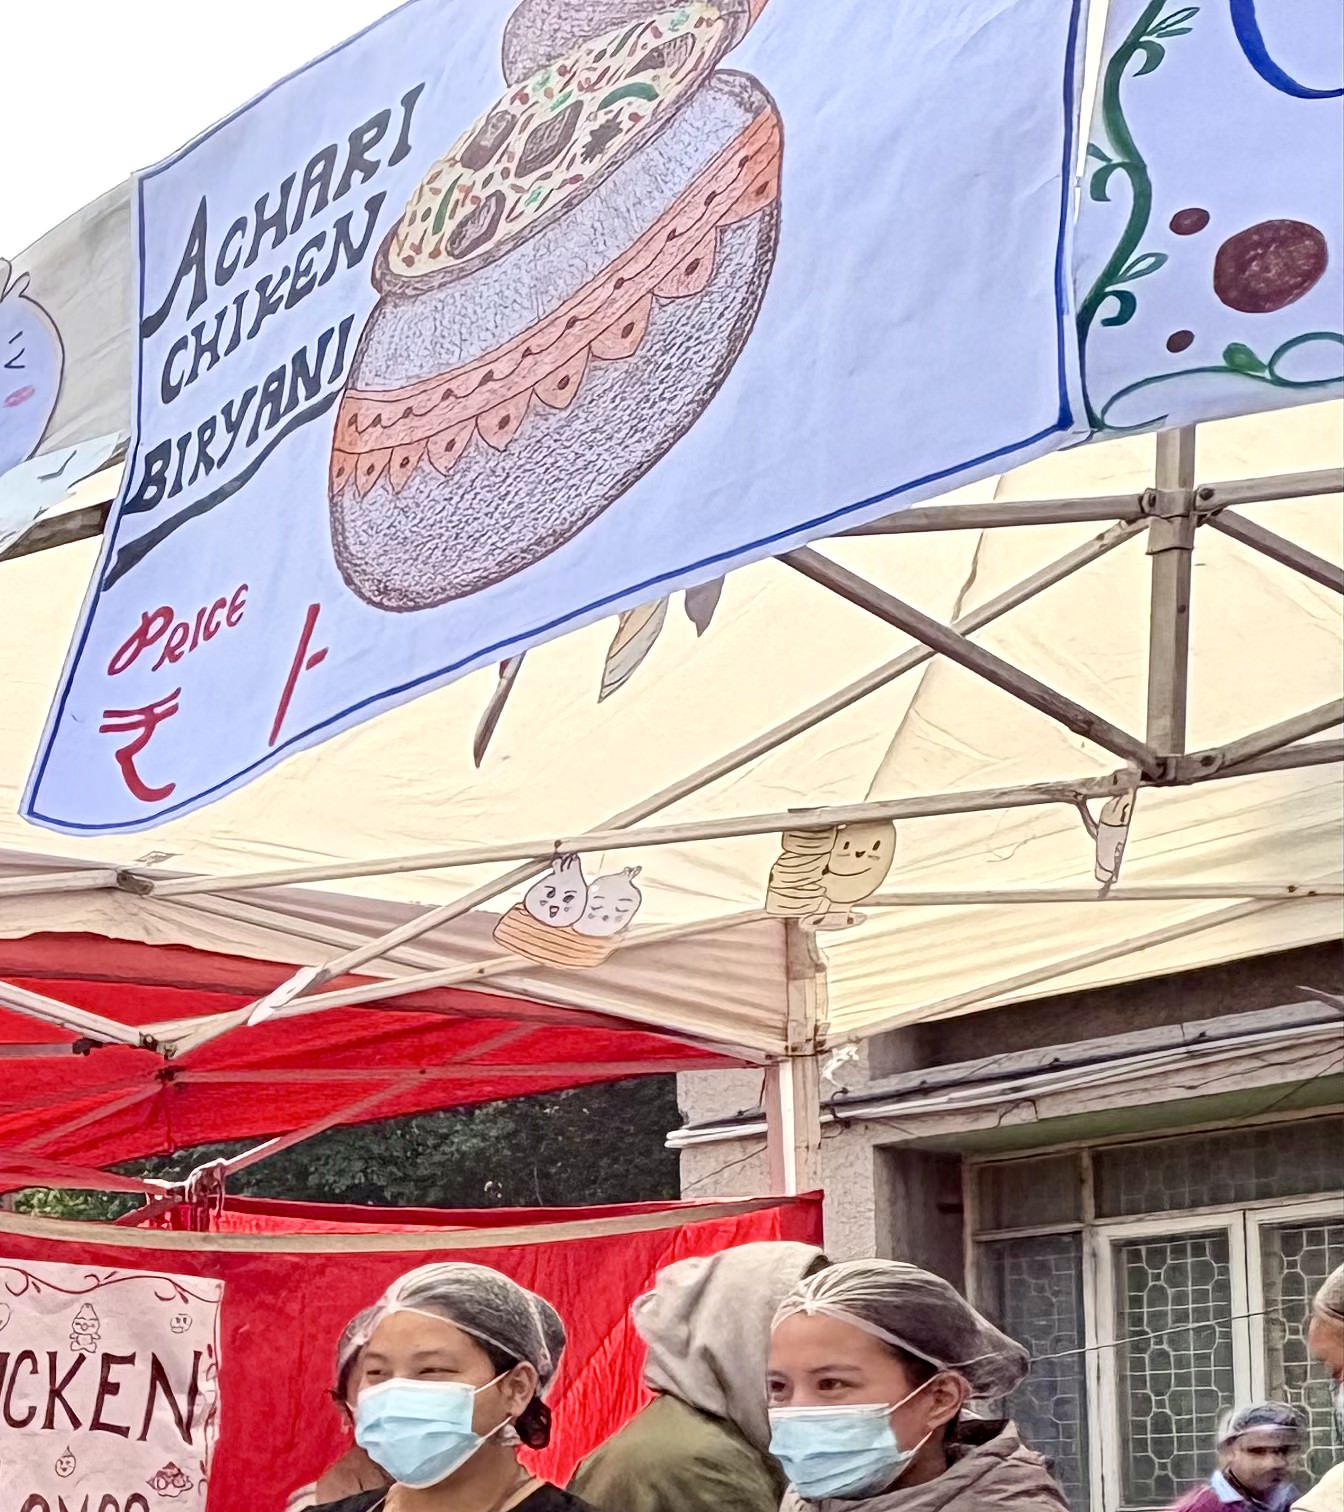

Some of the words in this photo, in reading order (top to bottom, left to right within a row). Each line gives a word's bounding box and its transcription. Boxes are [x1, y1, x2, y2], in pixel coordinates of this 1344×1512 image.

[141, 81, 426, 338] ACHARI
[161, 190, 387, 404] CHIKEN
[121, 313, 355, 515] BIRYANI
[107, 583, 248, 676] PRICE
